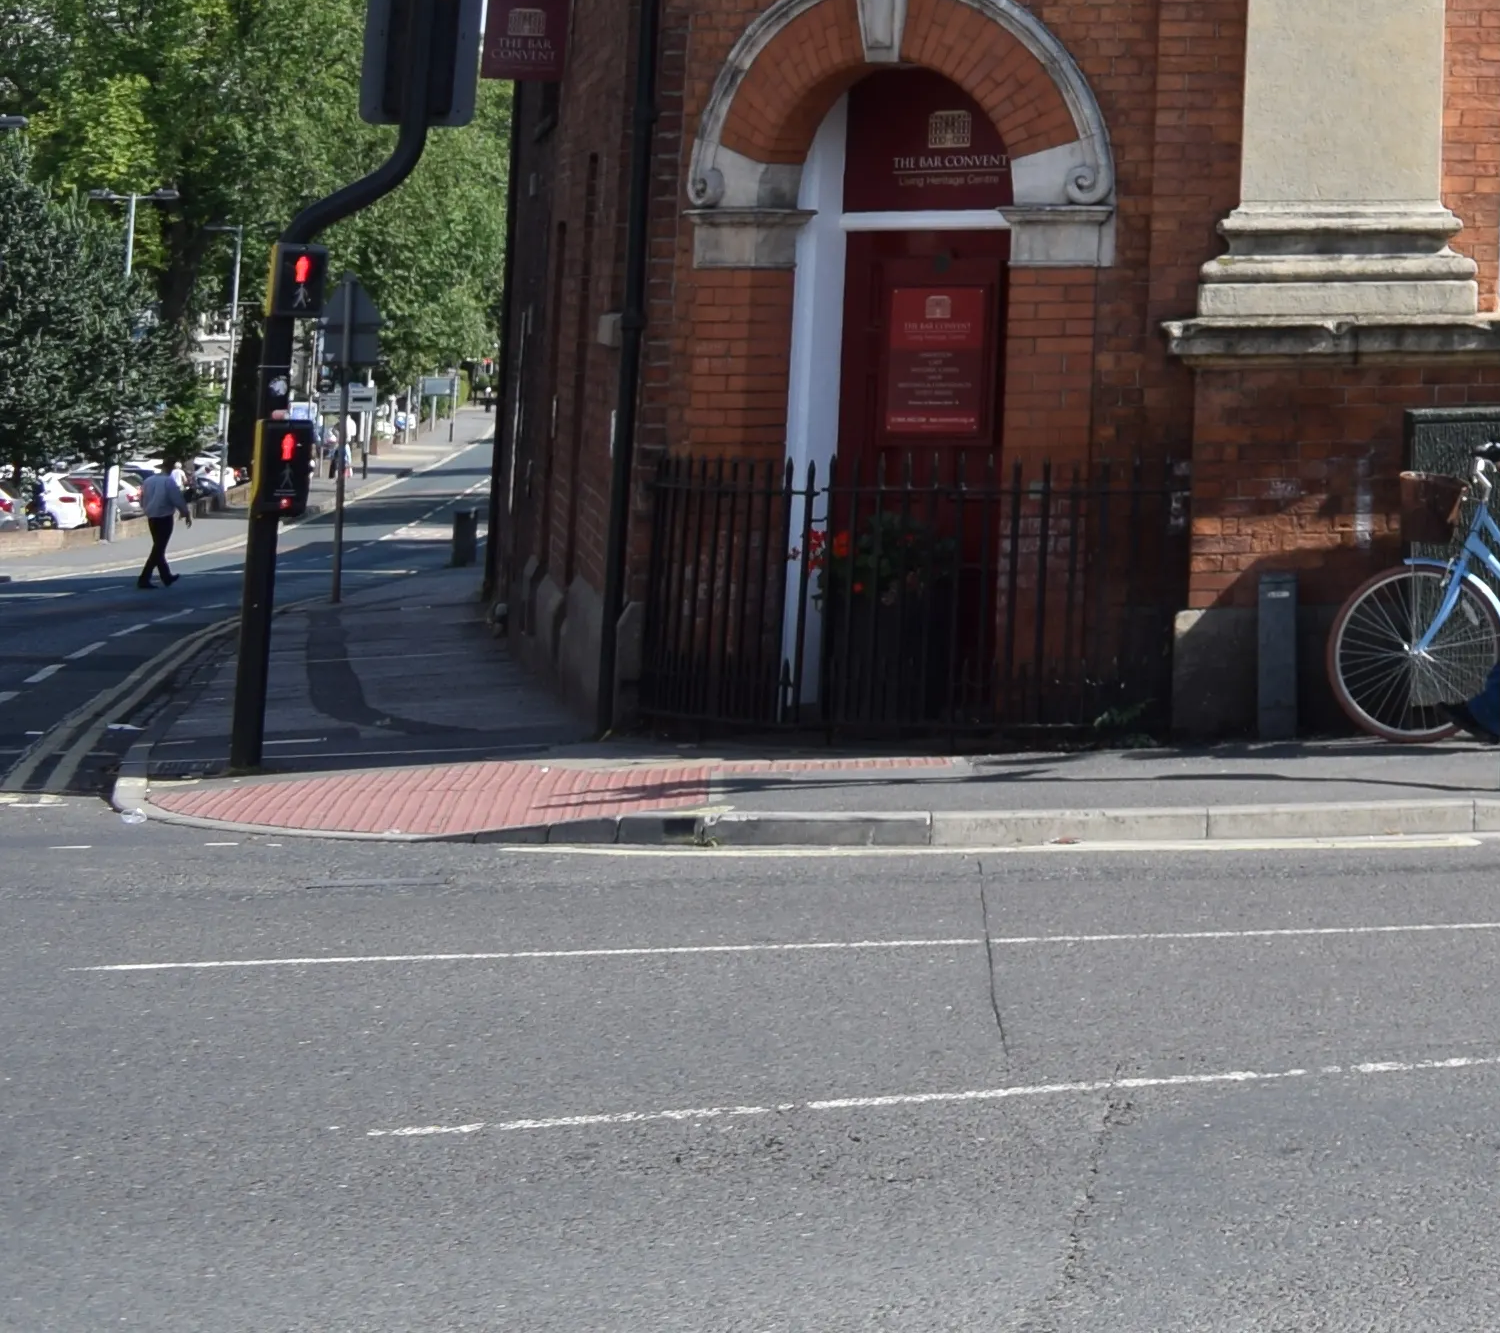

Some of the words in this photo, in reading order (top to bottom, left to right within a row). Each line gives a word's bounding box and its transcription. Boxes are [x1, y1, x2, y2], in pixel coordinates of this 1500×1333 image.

[496, 37, 521, 49] THE
[528, 38, 552, 49] BAR
[491, 48, 556, 62] CONVENT
[893, 157, 916, 169] THE
[918, 156, 942, 169] BAR
[944, 154, 1008, 168] CONVENT
[898, 175, 925, 187] Living
[926, 174, 965, 187] Heritage
[966, 174, 999, 185] Centre
